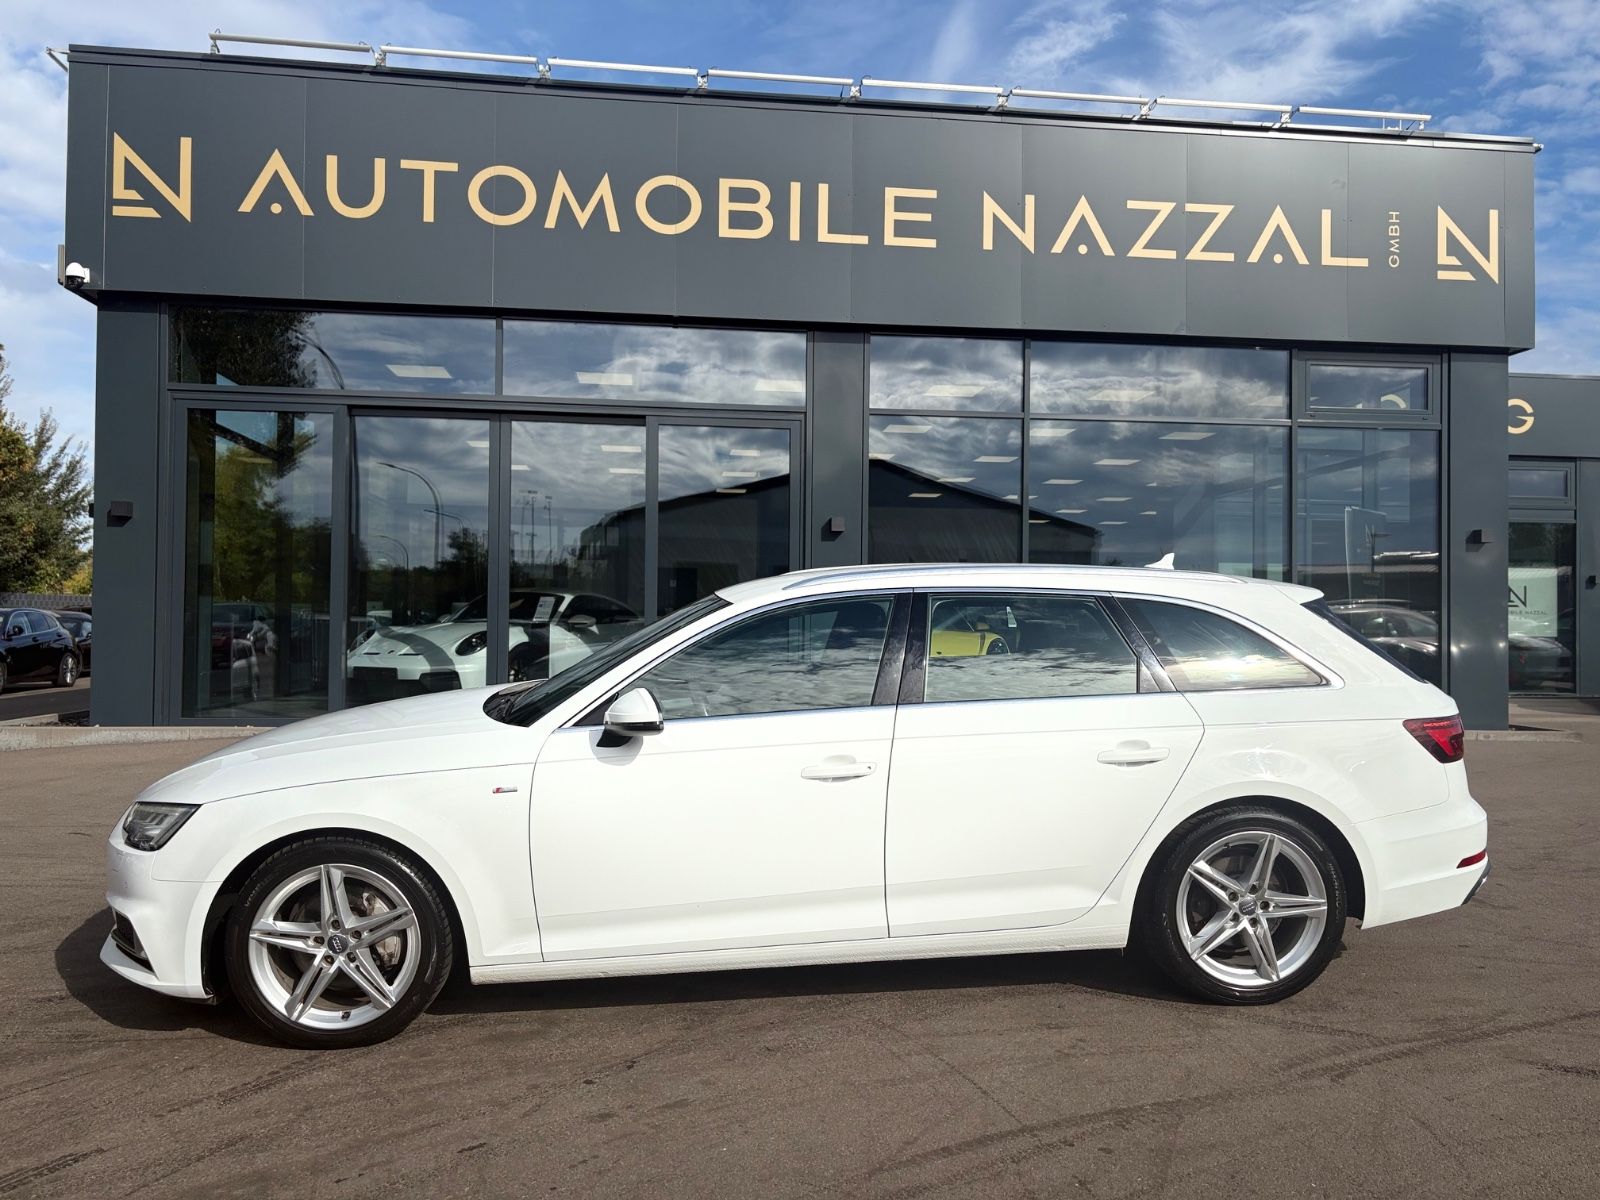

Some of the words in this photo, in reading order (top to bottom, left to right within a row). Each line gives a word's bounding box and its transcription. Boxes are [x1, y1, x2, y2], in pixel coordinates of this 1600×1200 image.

[238, 149, 938, 249] AUTOMOBILE
[981, 191, 1368, 269] NAZZAL
[1388, 211, 1400, 268] GMBH
